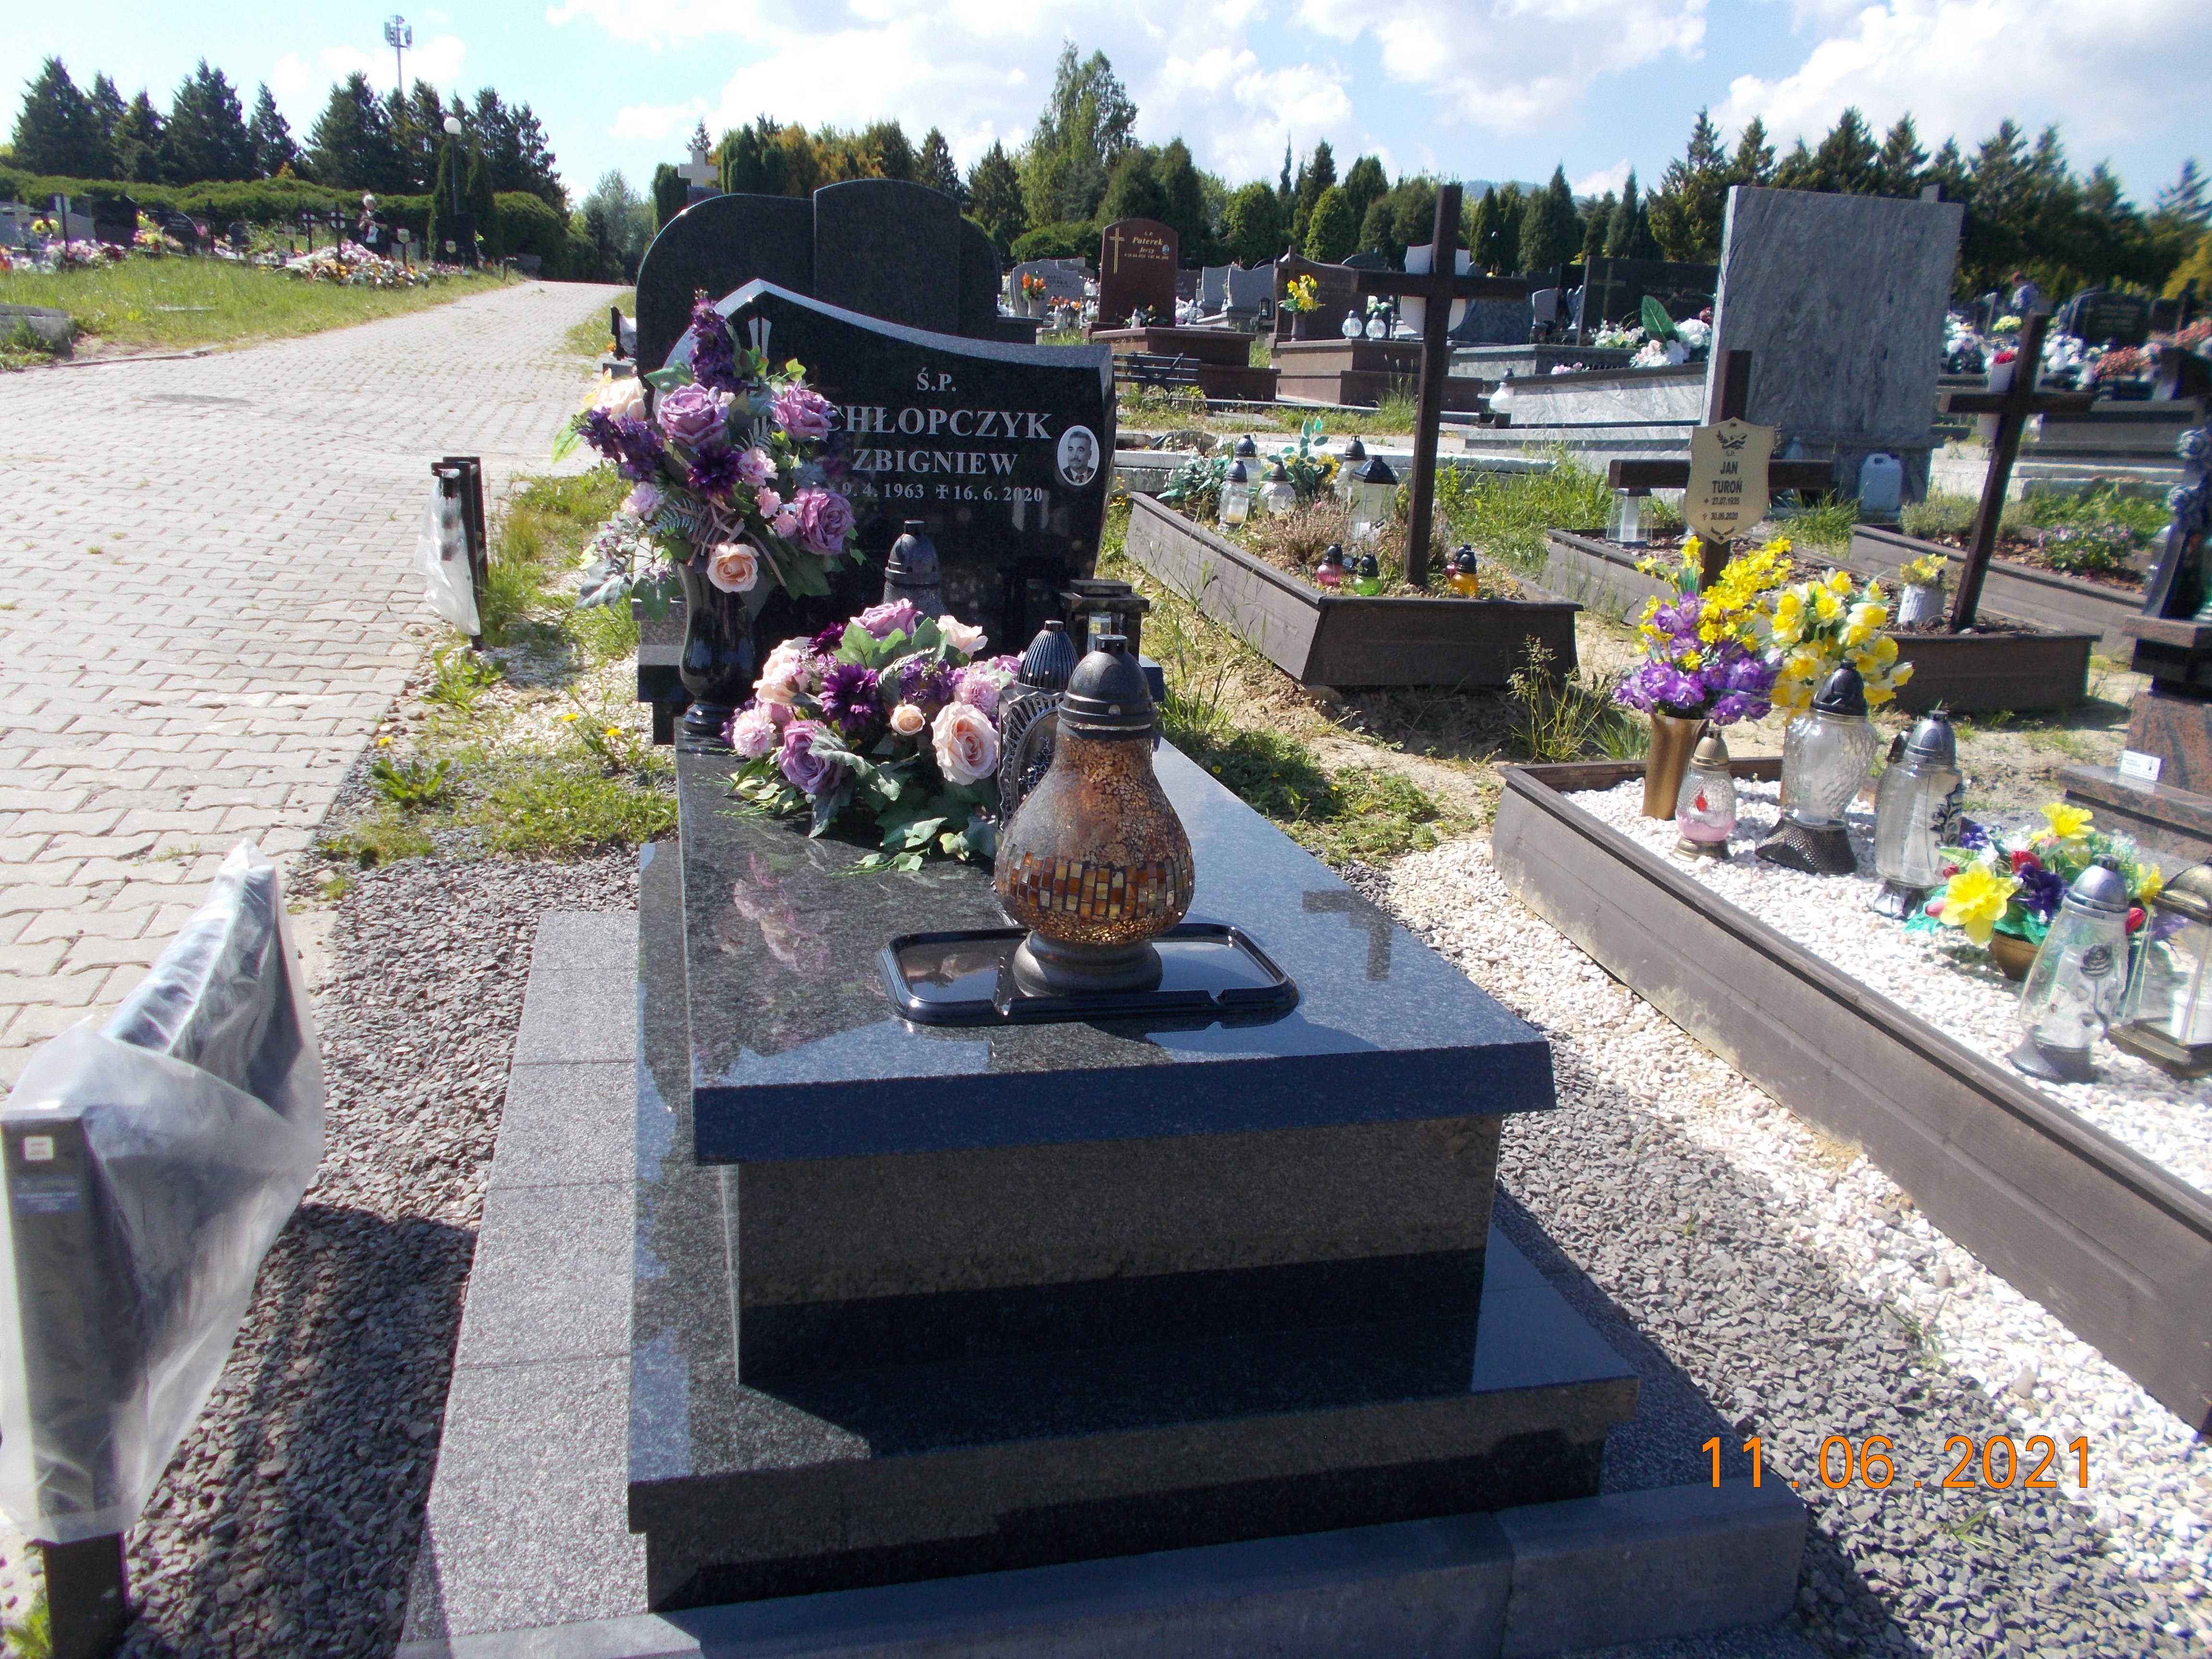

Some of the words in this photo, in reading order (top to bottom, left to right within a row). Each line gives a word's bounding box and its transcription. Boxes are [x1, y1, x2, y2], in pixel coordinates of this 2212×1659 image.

[1132, 236, 1163, 245] Paterek
[917, 367, 957, 392] Ś.P.
[852, 449, 1018, 476] ZBIGNIEW
[1720, 461, 1738, 474] JAN
[884, 483, 924, 499] 1963
[1003, 487, 1043, 502] 2020
[1712, 477, 1743, 493] TUROŃ
